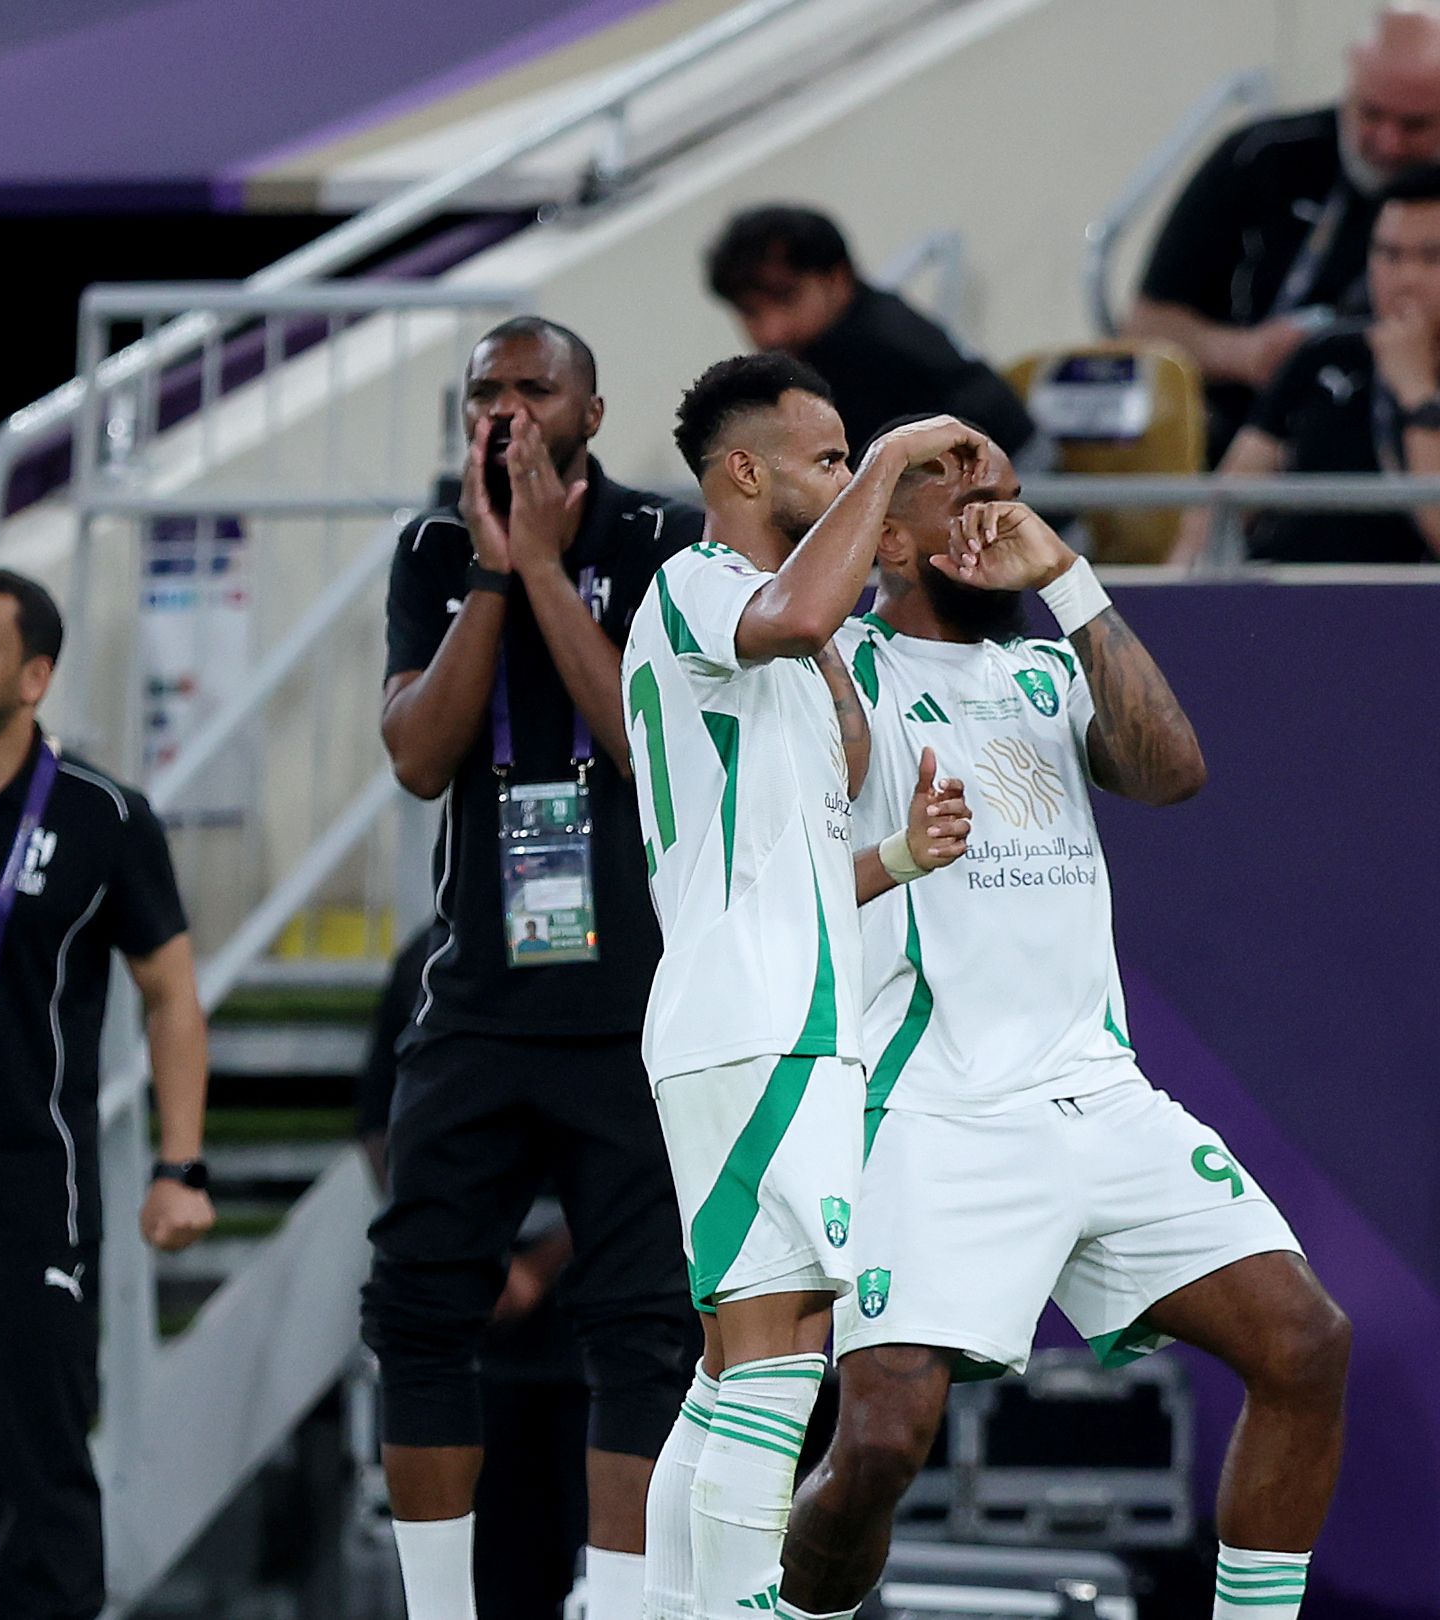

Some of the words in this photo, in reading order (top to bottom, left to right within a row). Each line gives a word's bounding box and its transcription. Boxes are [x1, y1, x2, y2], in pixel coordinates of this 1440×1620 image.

[968, 868, 1005, 890] Red
[1010, 868, 1044, 887] Sea
[1191, 1144, 1245, 1199] 9
